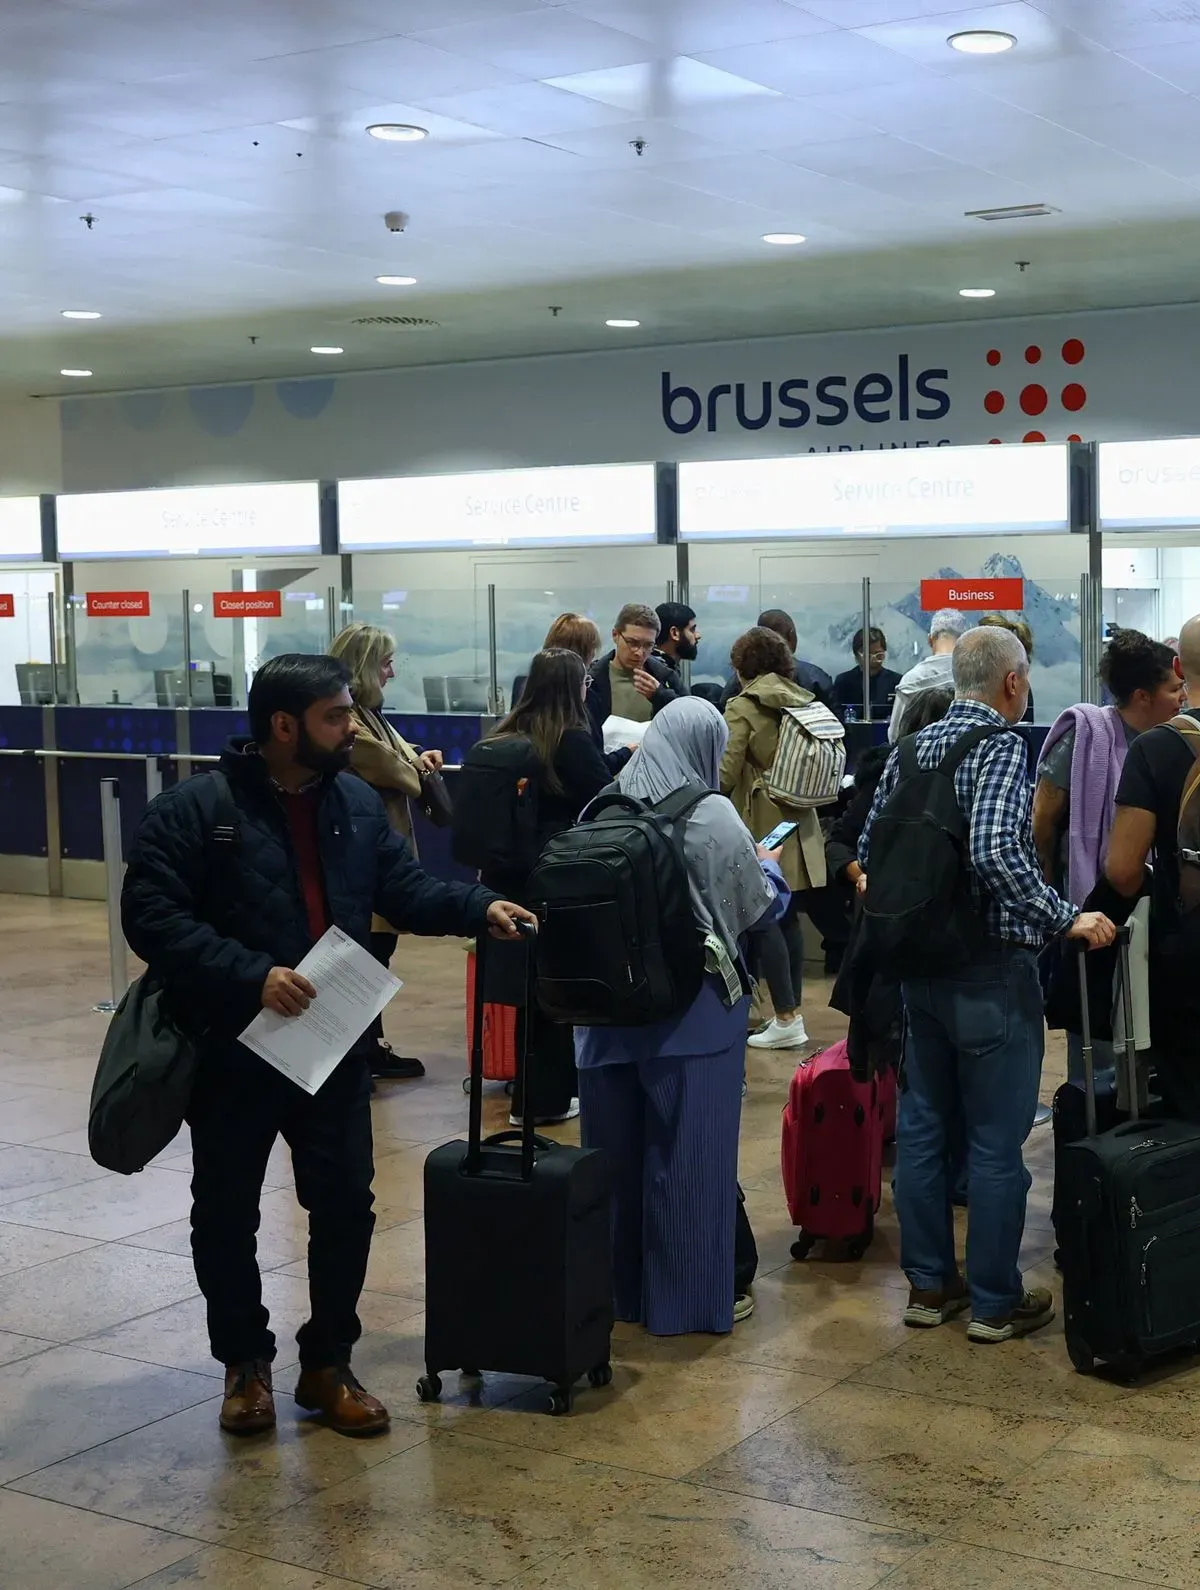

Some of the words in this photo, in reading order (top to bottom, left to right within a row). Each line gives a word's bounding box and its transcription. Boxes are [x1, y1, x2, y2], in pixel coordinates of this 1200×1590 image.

[661, 354, 951, 434] brussels
[906, 474, 974, 499] Centre
[948, 589, 995, 601] Business
[92, 600, 119, 610] Counter
[120, 600, 143, 609] closed
[220, 599, 245, 610] Closed
[246, 599, 274, 611] position
